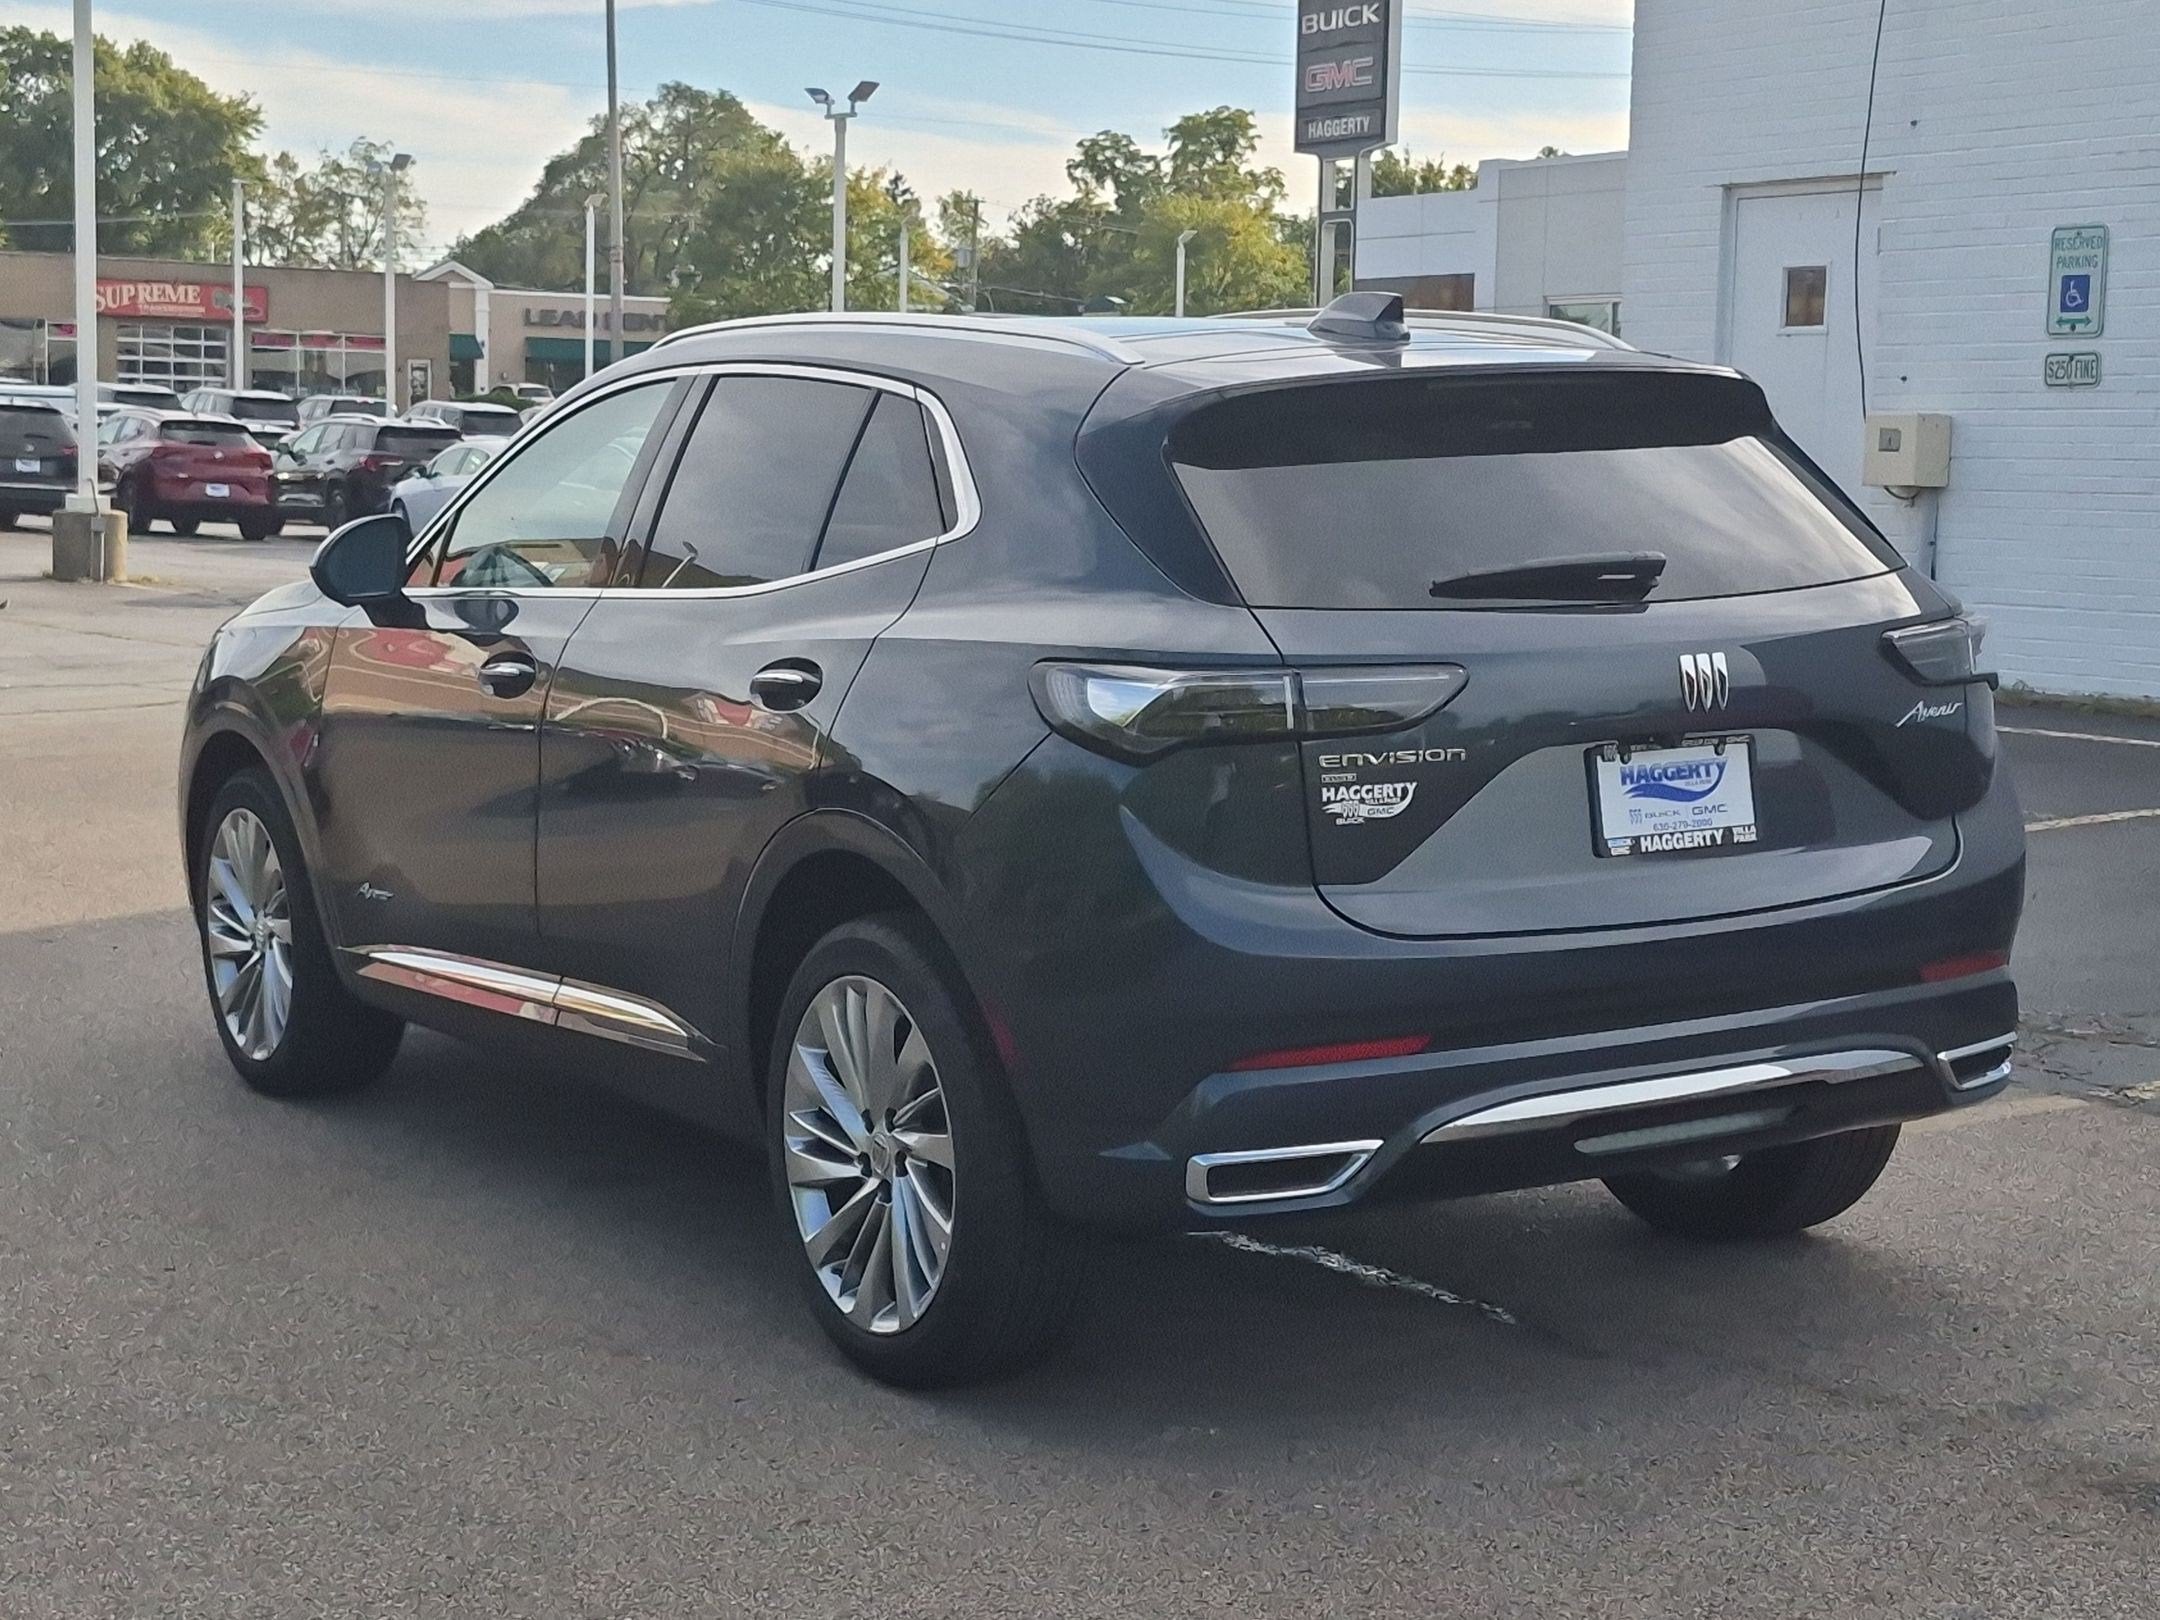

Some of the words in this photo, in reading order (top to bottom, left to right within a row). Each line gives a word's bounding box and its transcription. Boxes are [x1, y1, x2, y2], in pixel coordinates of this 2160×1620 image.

[1301, 3, 1380, 34] BUICK
[1305, 57, 1373, 92] GMC
[1308, 116, 1370, 138] HAGGERTY
[2054, 236, 2102, 250] RESERVED
[2057, 255, 2098, 270] PARKING
[96, 282, 201, 311] SUPREME
[2074, 359, 2096, 379] FINE
[1895, 700, 1963, 728] Avenir
[1621, 758, 1728, 786] HAGGERTY
[1321, 782, 1418, 802] HAGGERTY
[1336, 816, 1365, 825] BUICK
[1367, 807, 1395, 816] GMC
[1645, 809, 1681, 820] BUICK
[1692, 803, 1728, 816] GMC
[1640, 828, 1724, 853] HAGGERTY
